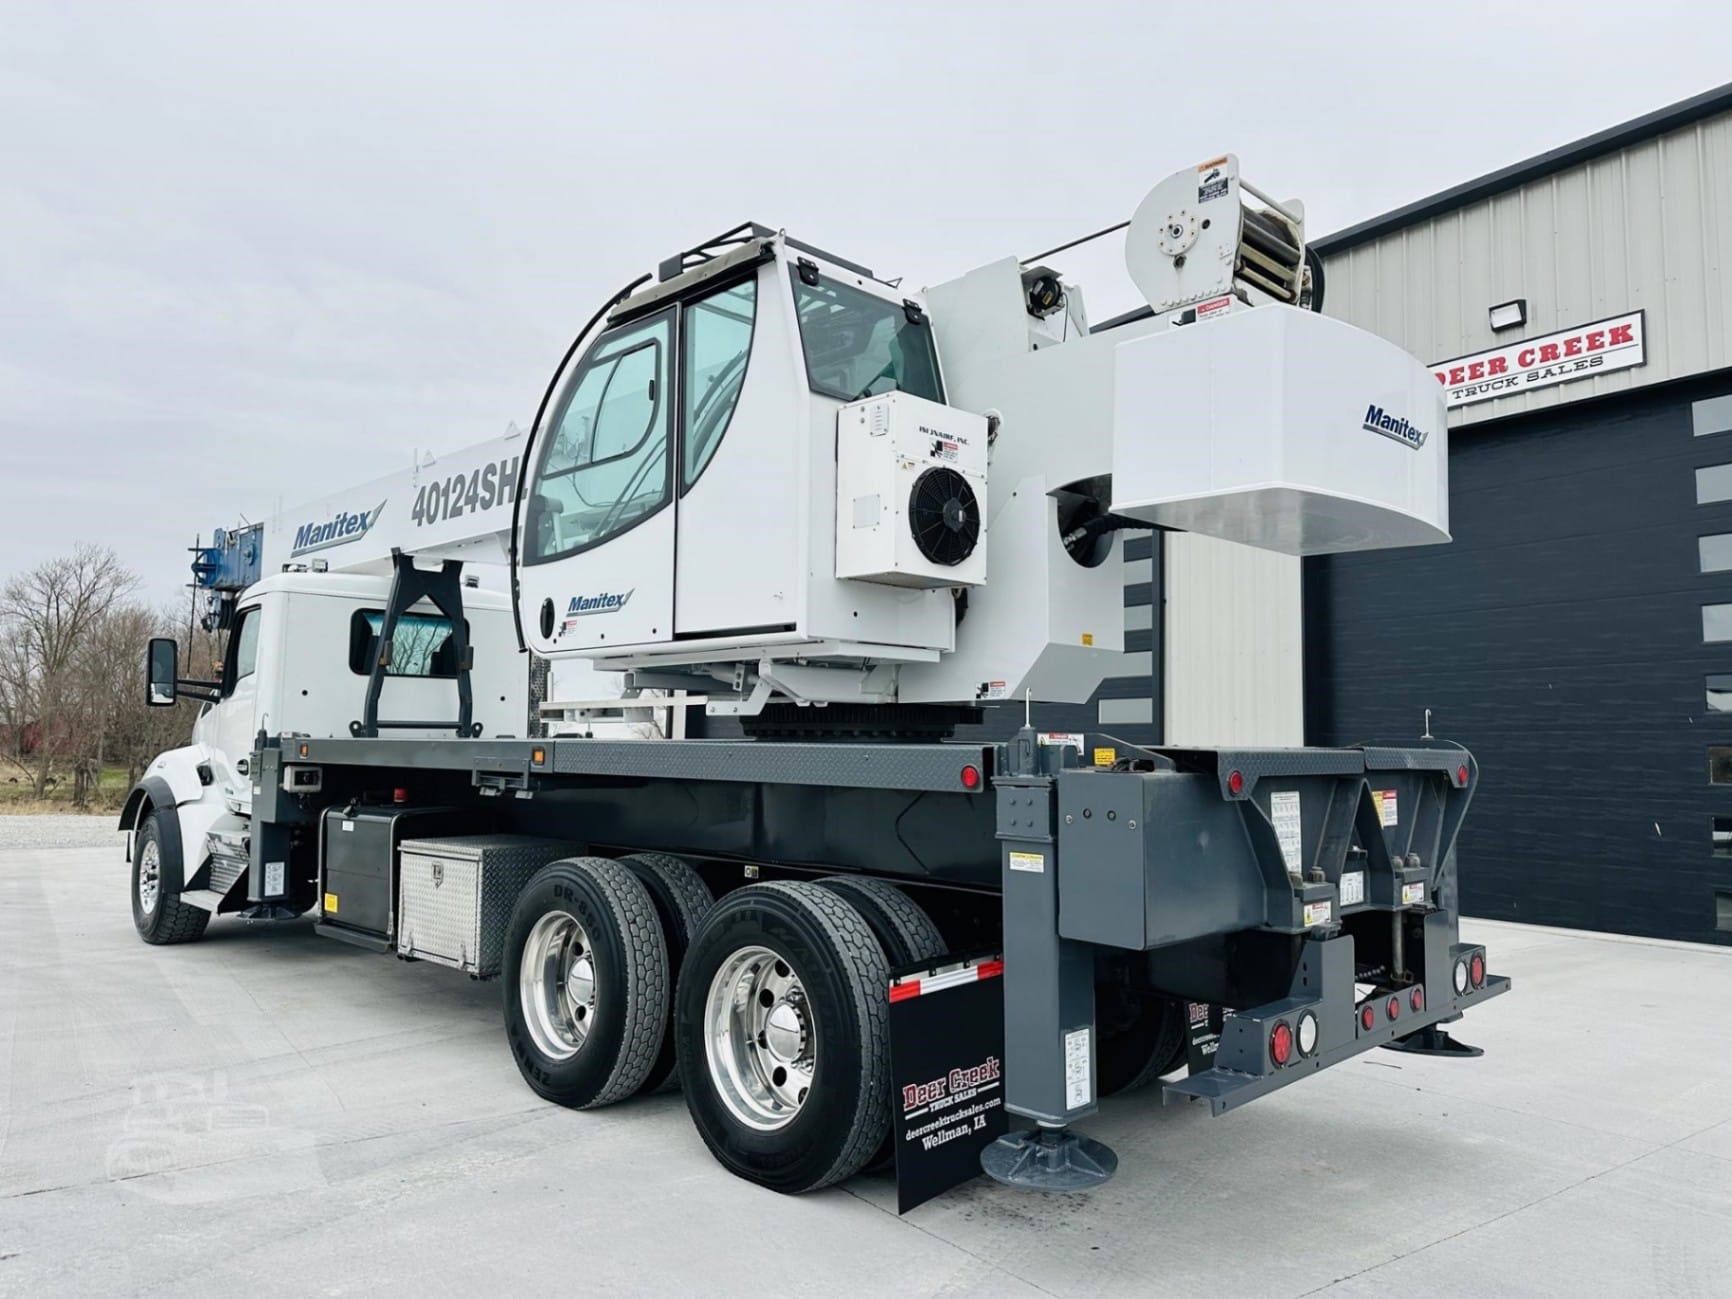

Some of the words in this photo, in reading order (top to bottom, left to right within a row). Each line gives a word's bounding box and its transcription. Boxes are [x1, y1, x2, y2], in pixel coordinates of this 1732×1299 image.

[1518, 323, 1634, 368] CREEK
[1452, 376, 1519, 400] TRUCK
[1526, 356, 1604, 383] SALES
[1365, 403, 1422, 444] Manitex
[411, 456, 528, 527] 40124SH
[293, 510, 372, 550] Manitex
[567, 592, 624, 612] Manitex
[903, 1077, 946, 1112] Deer
[949, 1056, 1000, 1093] Creek
[929, 1096, 954, 1112] TRUCK
[954, 1088, 977, 1104] SALES
[905, 1098, 1001, 1141] deercreektrucksales.com
[922, 1124, 972, 1151] Wellman,
[974, 1114, 987, 1130] IA
